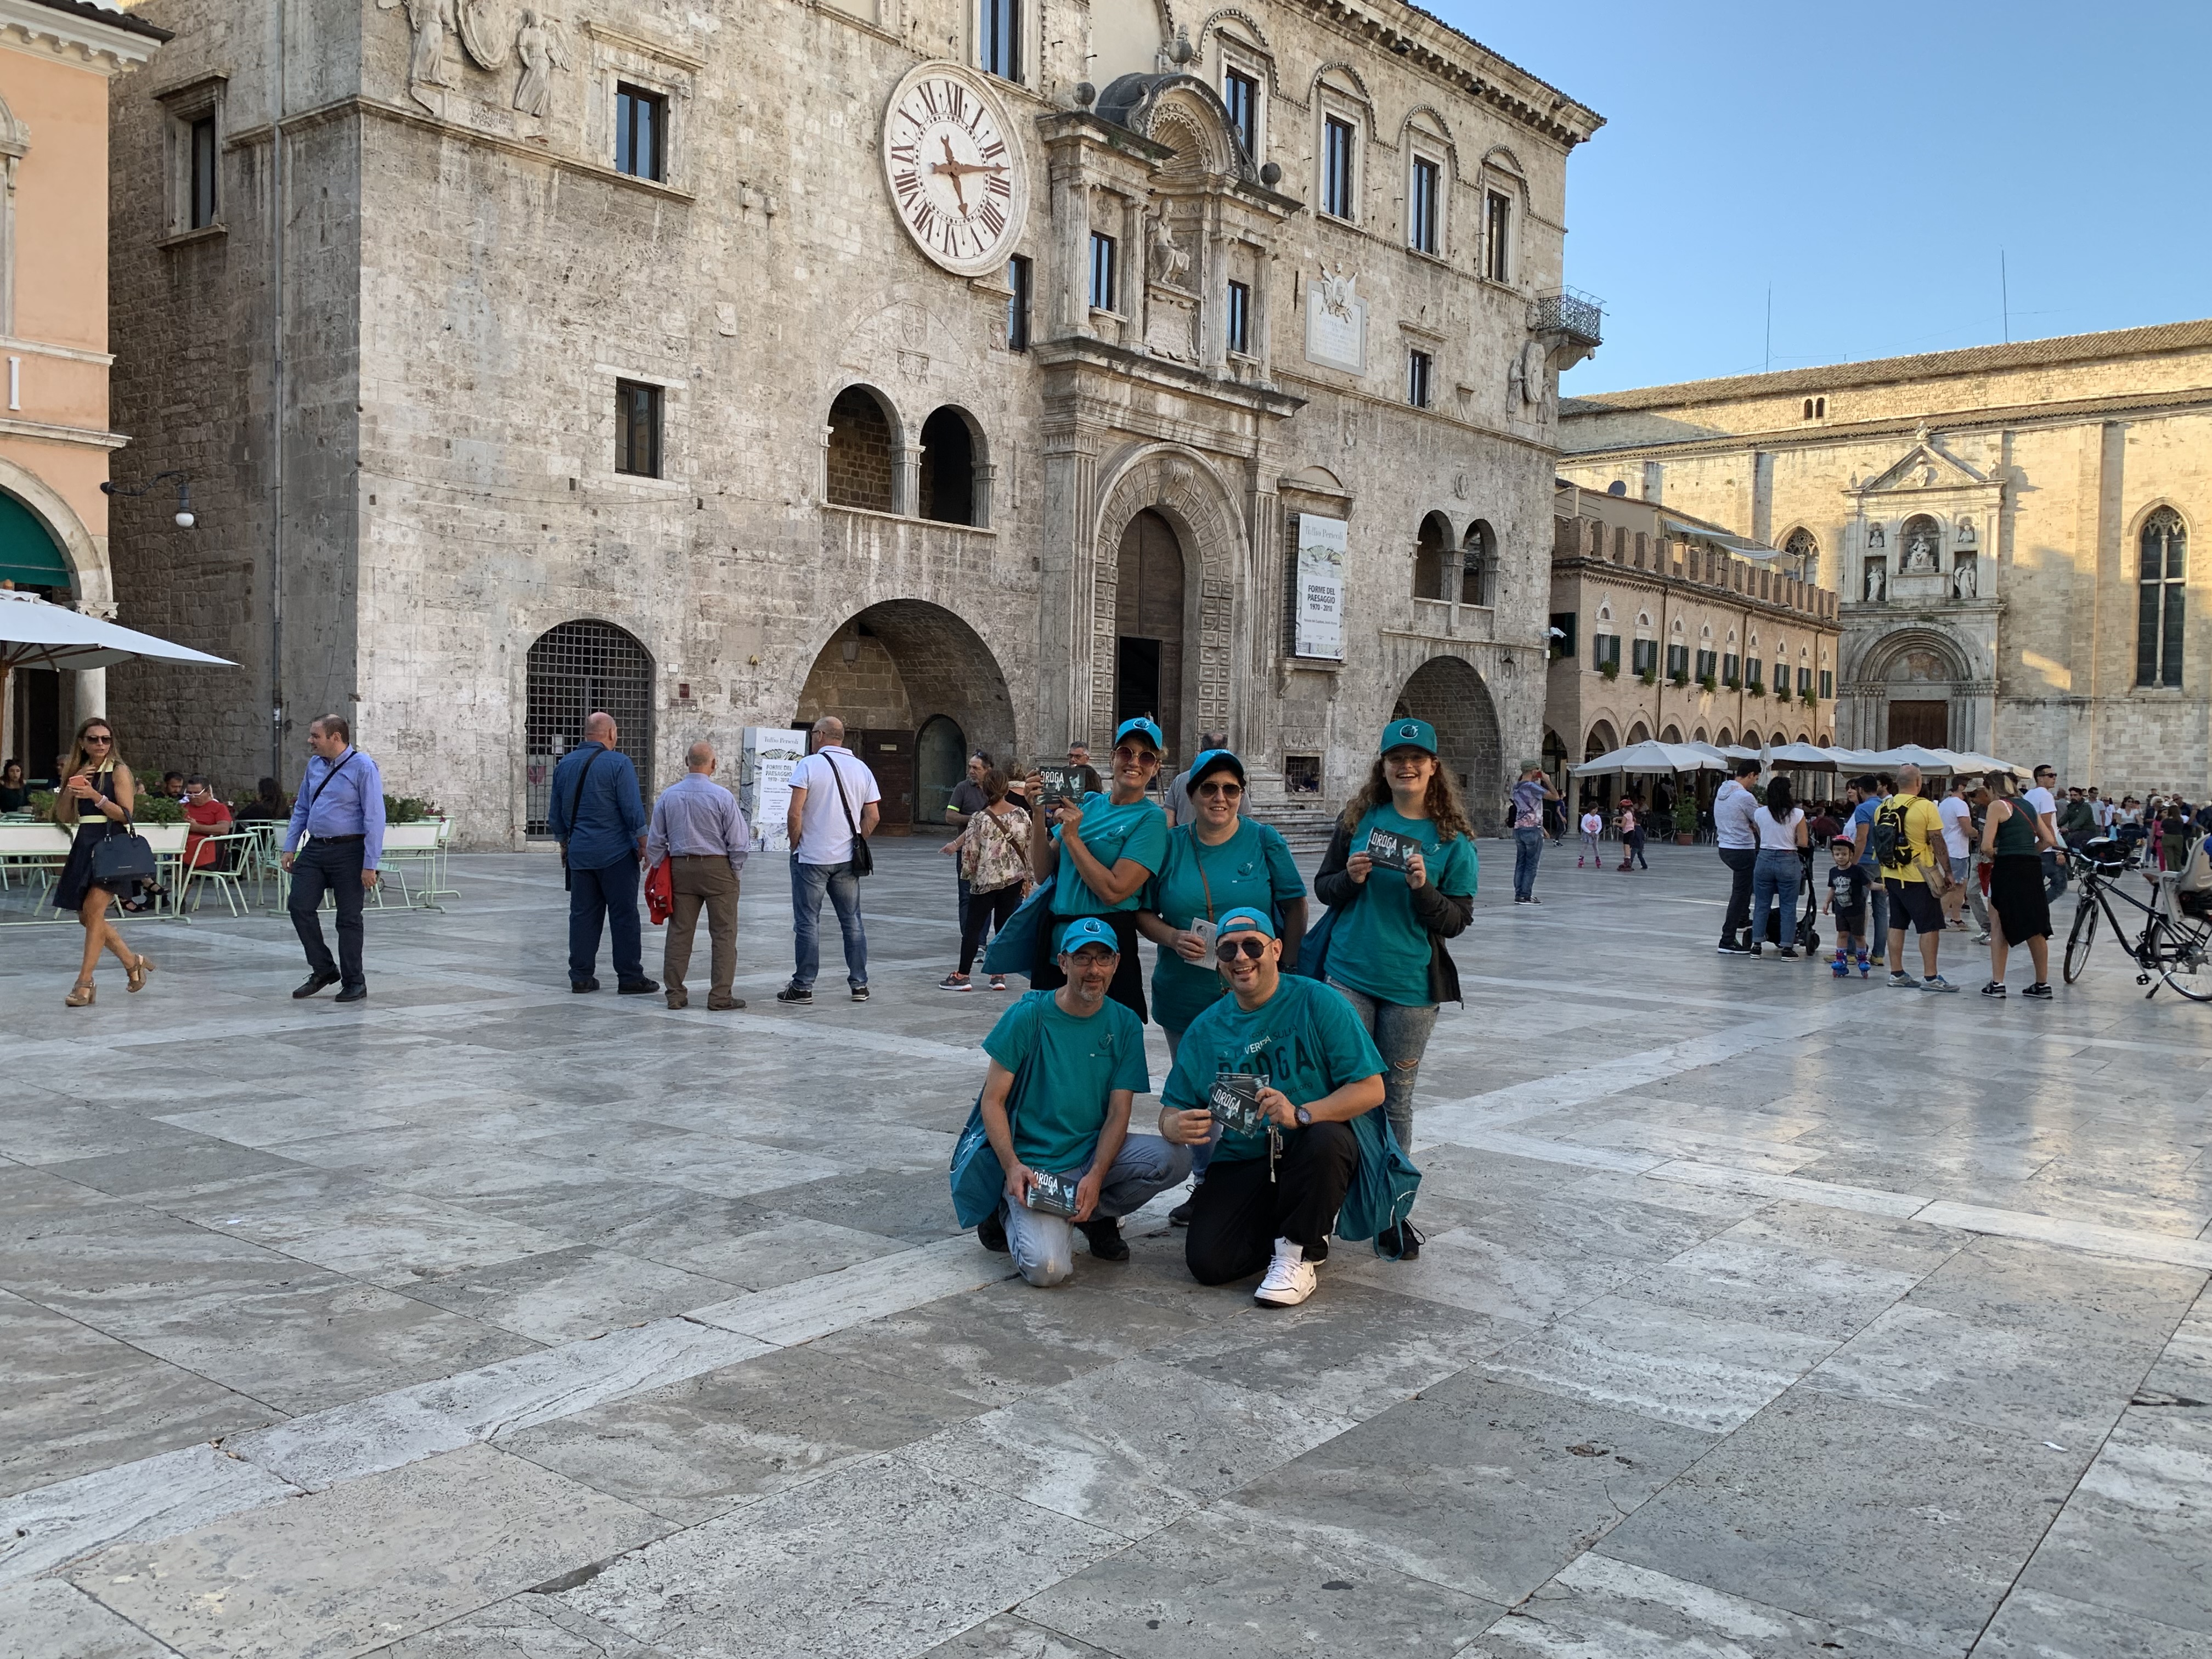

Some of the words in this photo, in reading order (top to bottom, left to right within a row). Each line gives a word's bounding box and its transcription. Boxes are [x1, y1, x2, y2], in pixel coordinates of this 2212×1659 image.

[945, 81, 964, 118] XII
[970, 106, 985, 129] I
[984, 140, 1007, 160] II
[990, 176, 1011, 198] III
[1305, 526, 1322, 537] Tullio
[1323, 529, 1344, 540] Pericoli
[1307, 594, 1335, 604] PAESAGGIO
[1308, 585, 1326, 594] FORME
[1327, 587, 1335, 595] DEL
[1040, 771, 1064, 783] DROGA
[1372, 832, 1397, 850] DROGA
[1214, 1089, 1241, 1113] DROGA
[1034, 1171, 1058, 1190] DROGA
